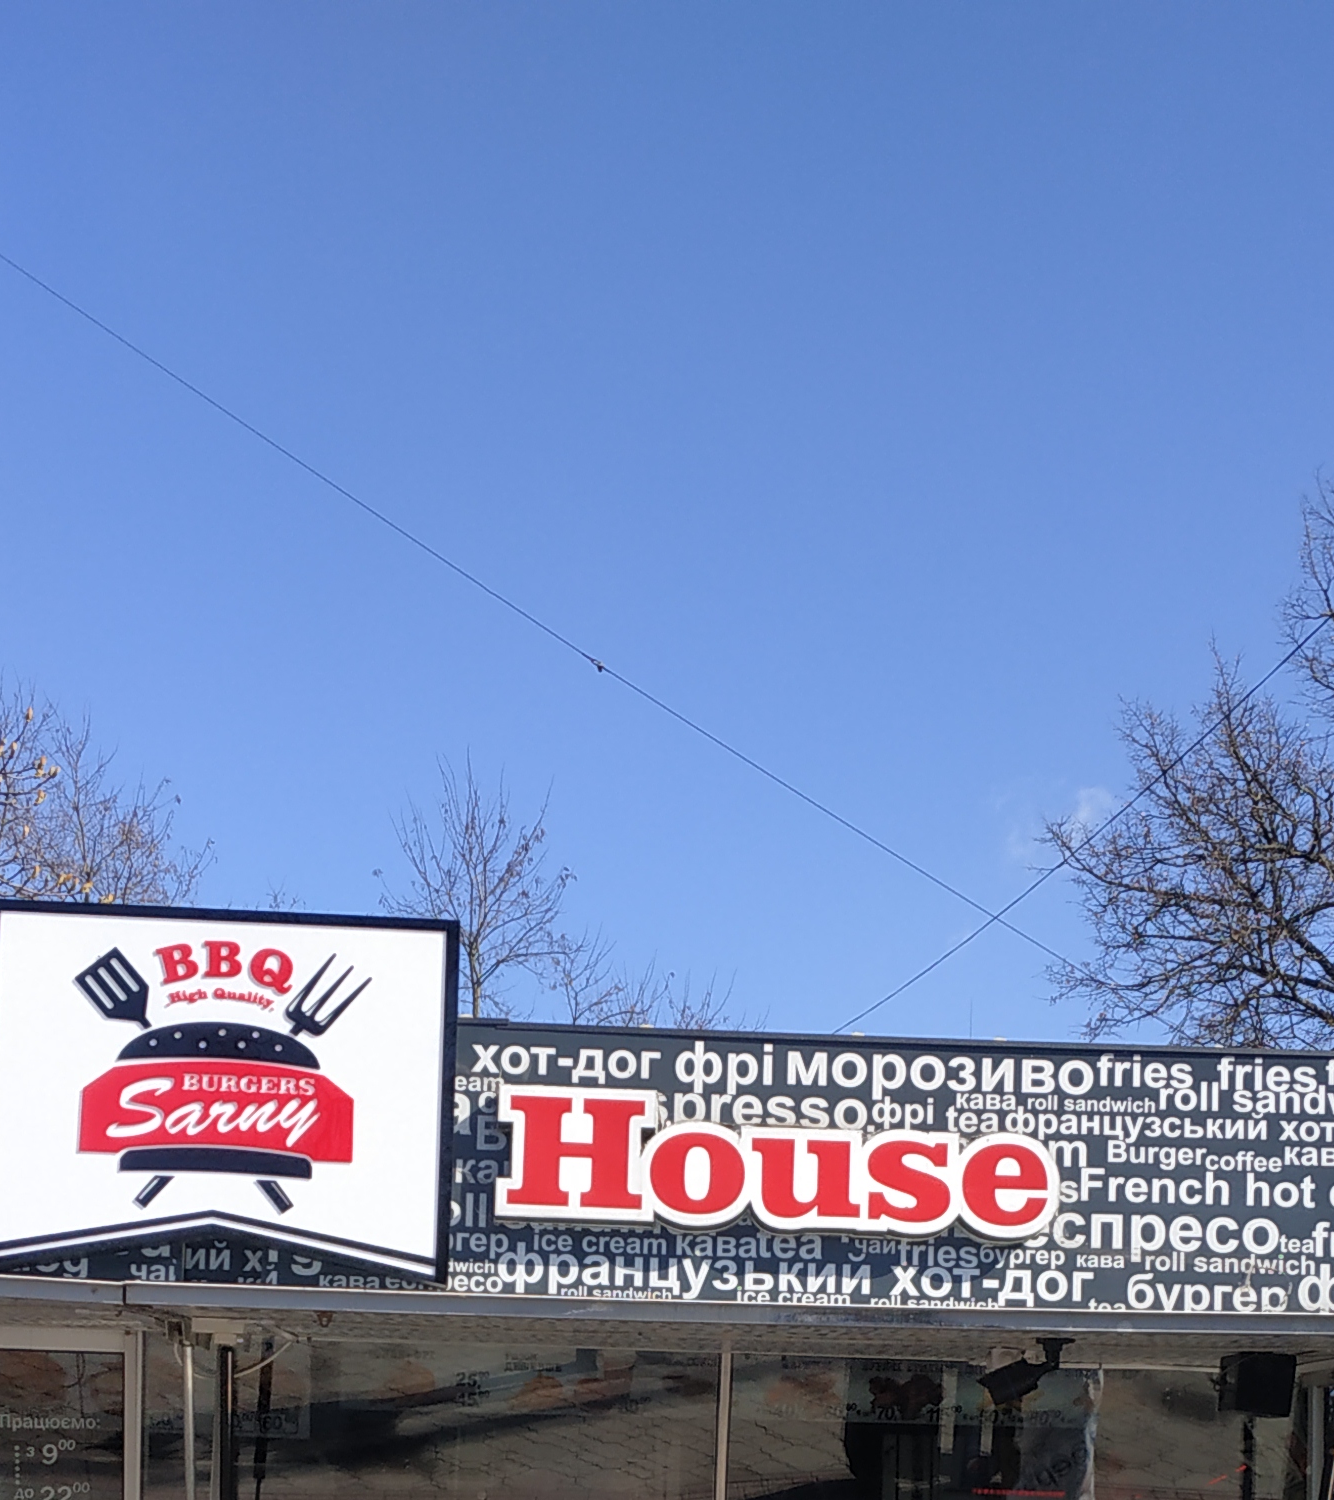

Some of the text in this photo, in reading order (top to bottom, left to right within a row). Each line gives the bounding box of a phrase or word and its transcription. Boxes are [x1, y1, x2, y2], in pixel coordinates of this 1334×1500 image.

[156, 941, 293, 993] BBQ
[182, 1073, 315, 1096] BURGERS
[472, 1045, 660, 1084] хот-дог
[675, 1041, 773, 1093] фрі
[787, 1048, 1094, 1101] морозиво
[1098, 1056, 1192, 1089] fries
[1218, 1057, 1316, 1093] fries
[106, 1078, 319, 1147] Sarny
[872, 1098, 933, 1130] фрі
[956, 1093, 1015, 1110] кава
[1028, 1095, 1058, 1111] roll
[1064, 1096, 1155, 1114] sandwich
[1160, 1082, 1220, 1112] roll
[506, 1095, 1050, 1228] House
[1108, 1140, 1282, 1173] Burger coffee
[1081, 1168, 1229, 1206] French
[1246, 1172, 1316, 1209] hot
